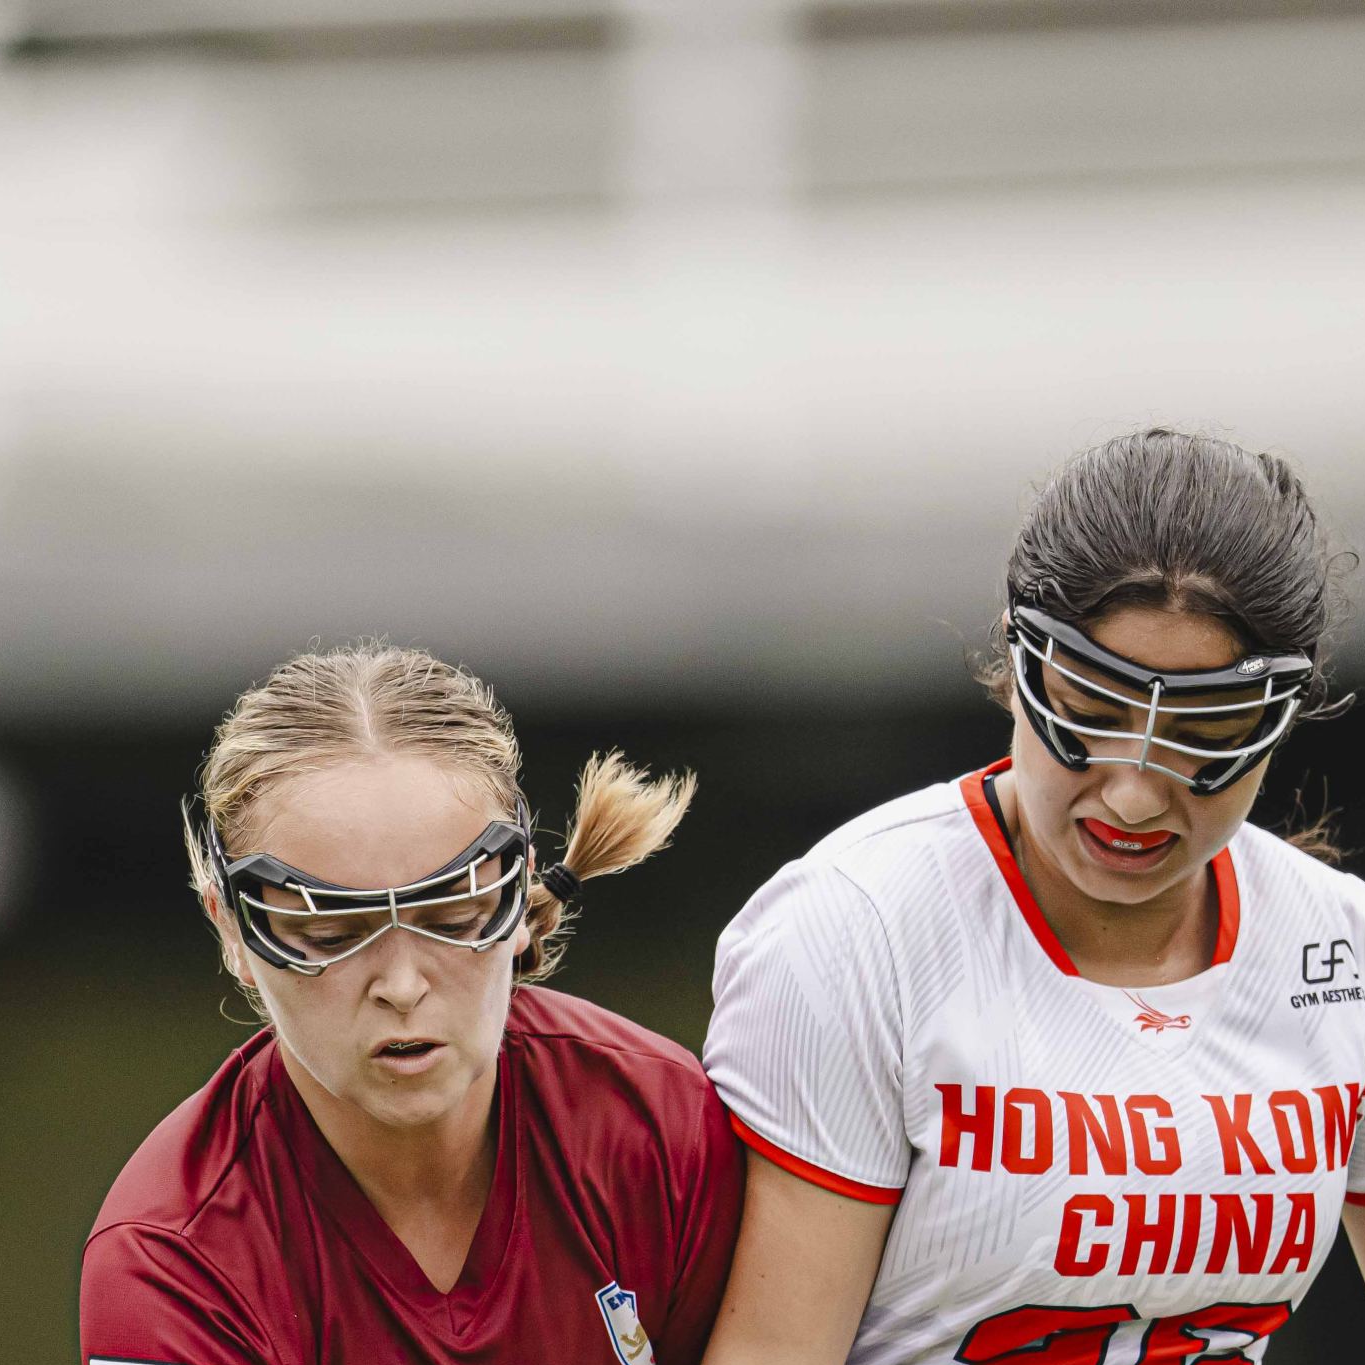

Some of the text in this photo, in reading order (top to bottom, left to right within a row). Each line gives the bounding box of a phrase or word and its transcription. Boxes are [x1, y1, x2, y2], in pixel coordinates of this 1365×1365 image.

[1290, 992, 1319, 1009] GYM
[935, 1083, 1182, 1176] HONG
[1053, 1192, 1316, 1277] CHINA
